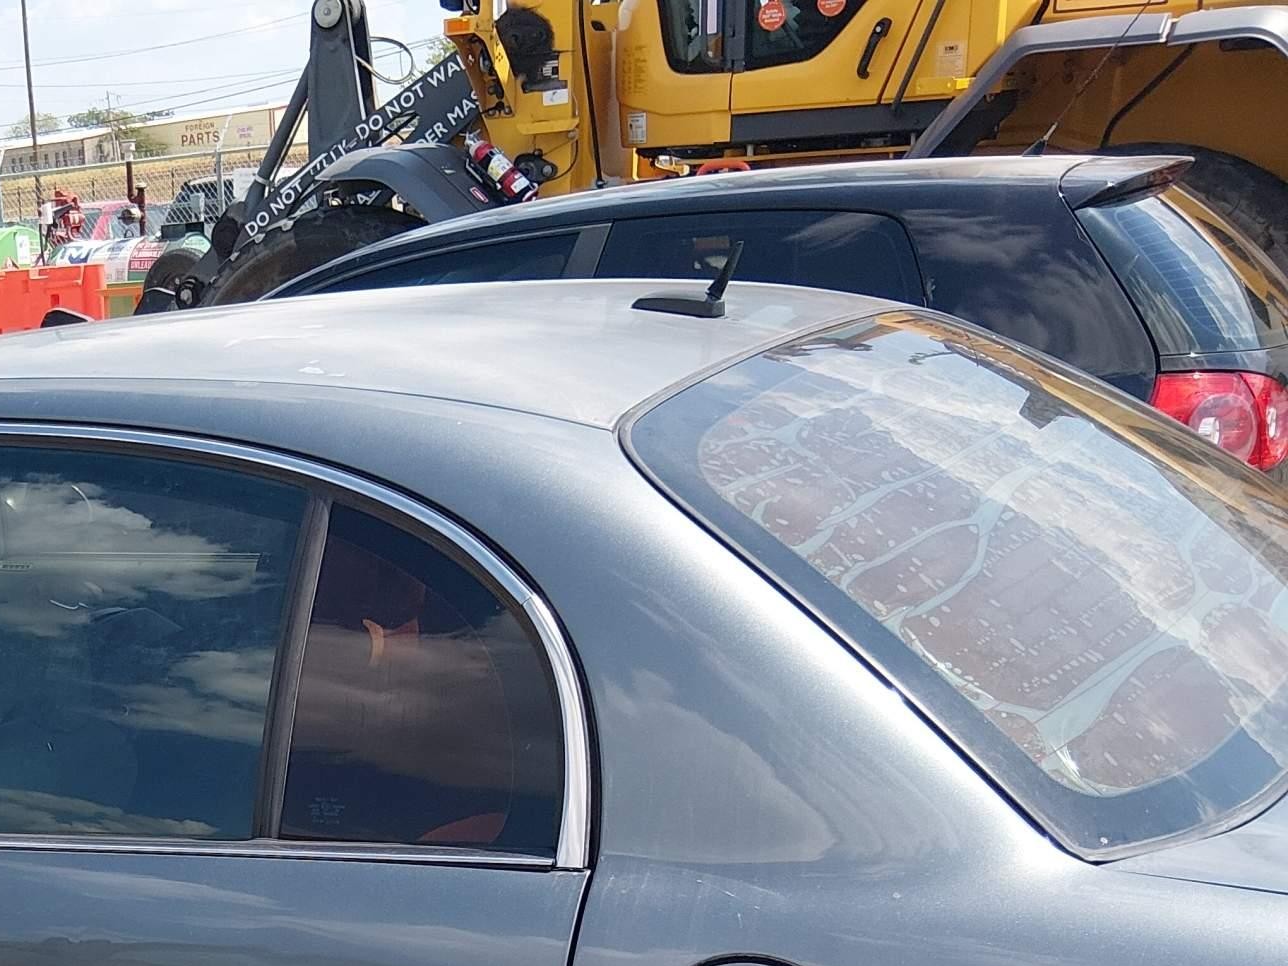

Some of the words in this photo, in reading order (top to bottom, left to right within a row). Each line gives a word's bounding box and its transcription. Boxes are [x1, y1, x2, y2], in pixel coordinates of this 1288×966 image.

[185, 122, 215, 132] FOREIGN
[355, 115, 383, 140] DO
[385, 82, 424, 119] NOT
[181, 130, 220, 147] PARTS
[245, 211, 270, 237] DO
[269, 179, 303, 216] NOT
